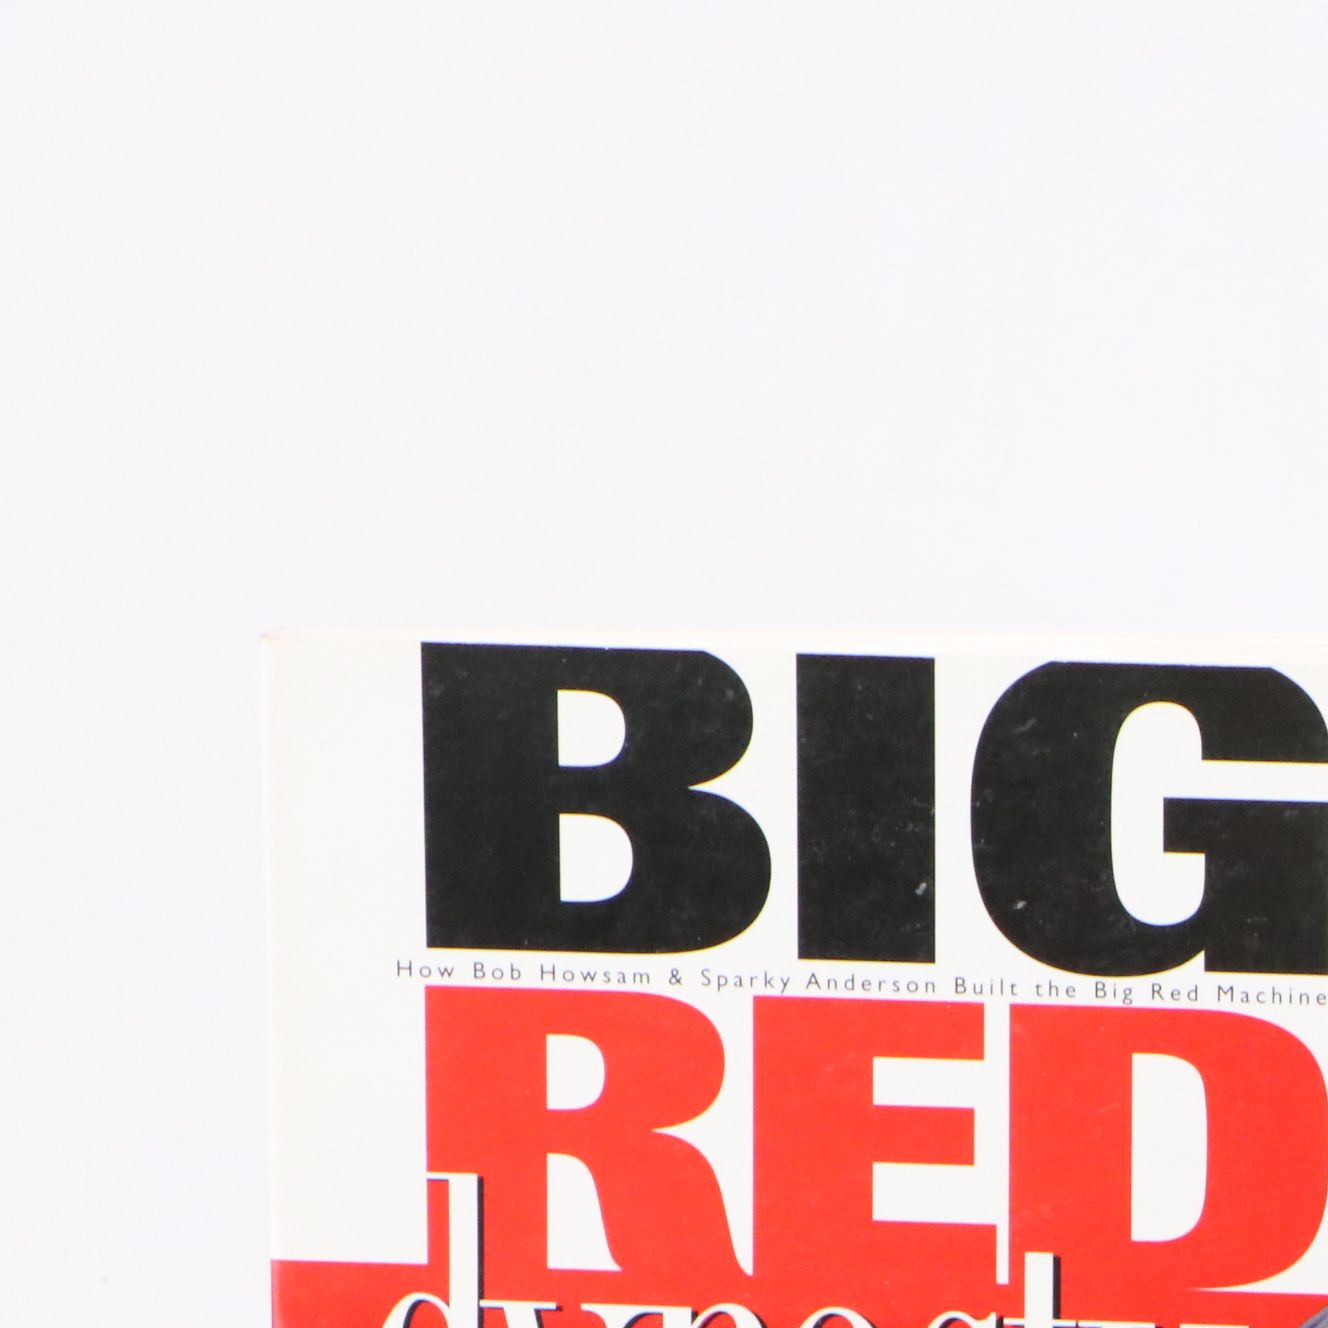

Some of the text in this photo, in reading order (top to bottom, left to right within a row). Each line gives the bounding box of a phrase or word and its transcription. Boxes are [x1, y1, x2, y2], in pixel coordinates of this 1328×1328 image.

[396, 959, 1328, 1005] How Bob Howsam & Sparky Anderson Built the Big Red Machine
